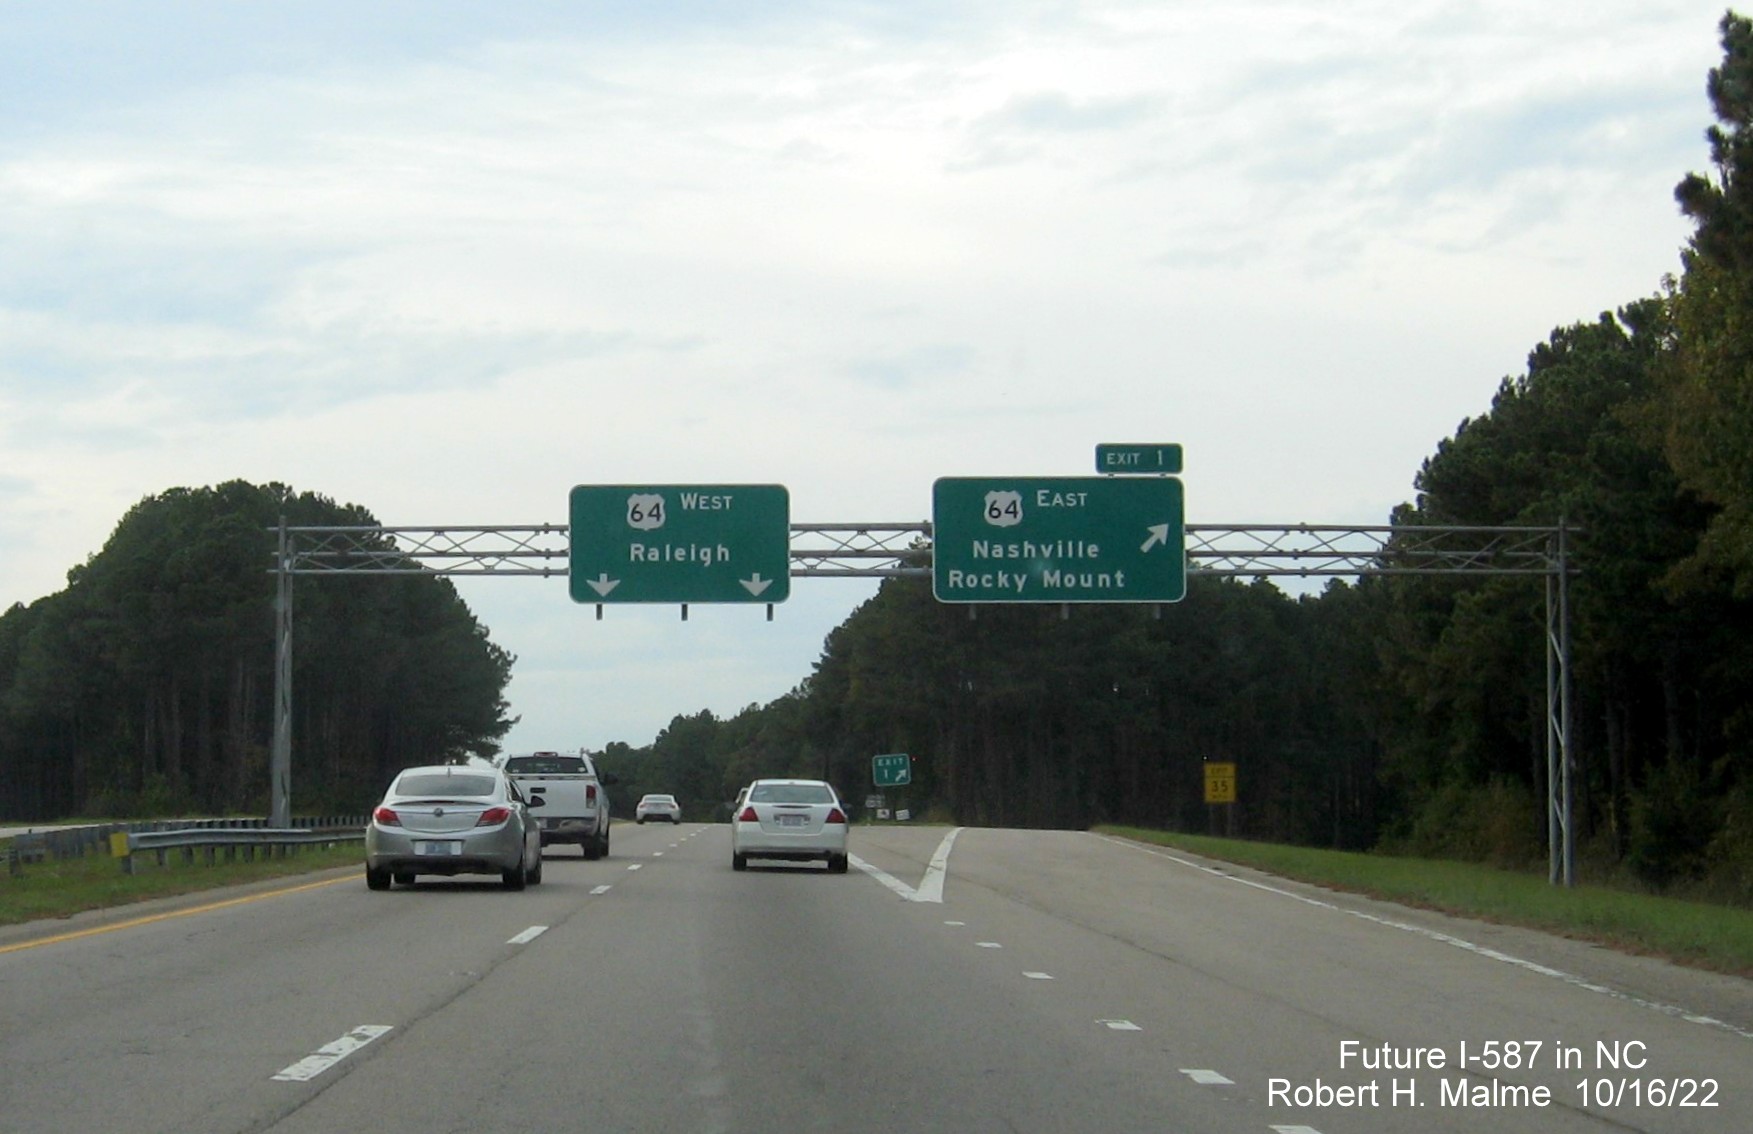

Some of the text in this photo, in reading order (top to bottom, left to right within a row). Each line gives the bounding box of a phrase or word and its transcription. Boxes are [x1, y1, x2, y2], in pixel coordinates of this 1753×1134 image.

[1106, 449, 1164, 466] EXIT 1
[679, 492, 733, 510] WEST
[1036, 489, 1088, 507] EAST
[629, 502, 662, 523] 64
[987, 500, 1020, 519] 64
[629, 543, 730, 567] Raleigh
[973, 540, 1100, 558] Nashville
[948, 570, 1125, 592] Rocky Mount
[877, 757, 904, 767] EXIT
[884, 769, 889, 779] 1
[1211, 780, 1229, 793] 35
